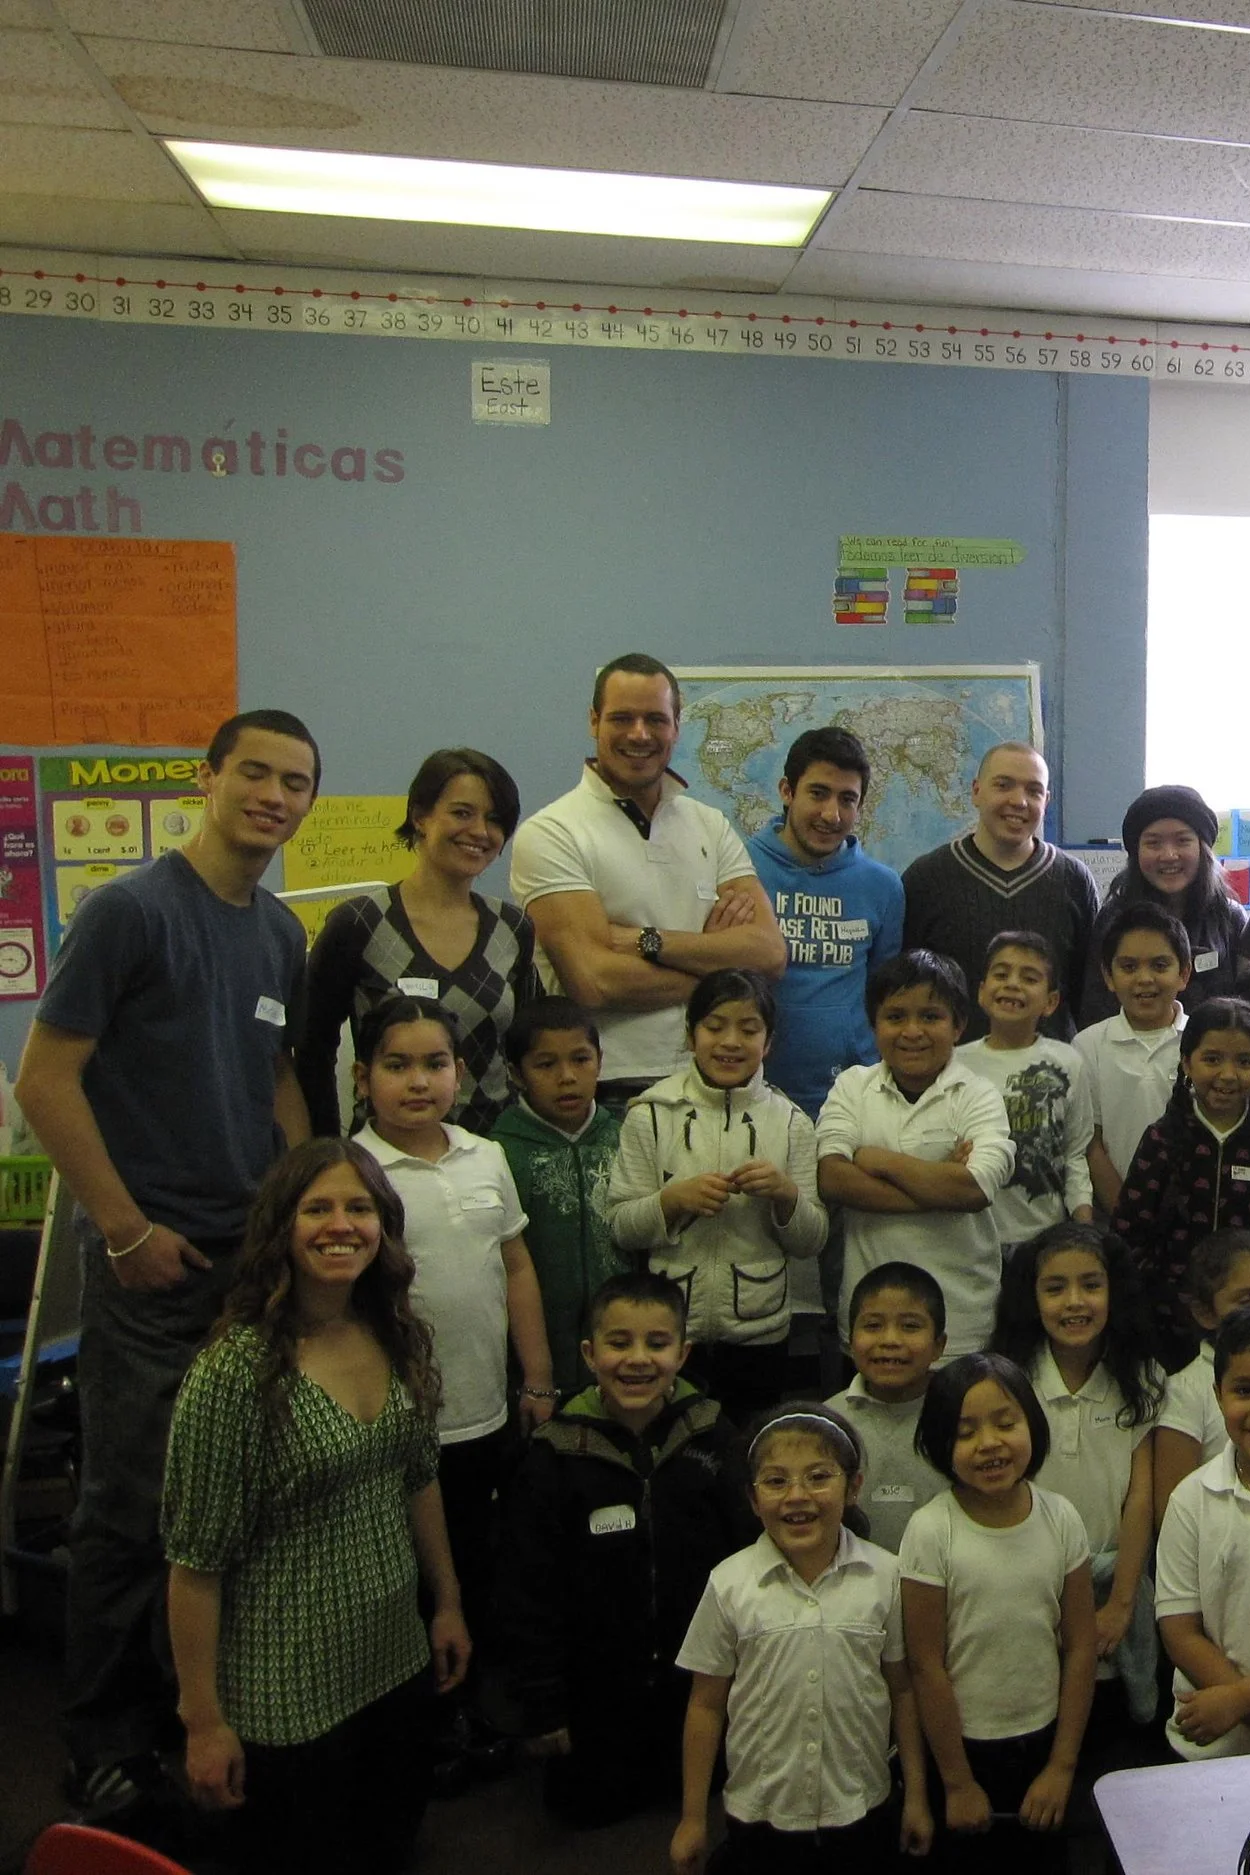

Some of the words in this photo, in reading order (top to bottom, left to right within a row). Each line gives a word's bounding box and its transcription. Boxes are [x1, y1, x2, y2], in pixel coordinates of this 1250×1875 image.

[25, 290, 52, 309] 29
[65, 292, 96, 313] 30
[113, 296, 131, 315] 31
[149, 298, 174, 318] 32
[188, 301, 215, 321] 33
[228, 303, 253, 322] 34
[267, 305, 292, 325] 35
[305, 307, 330, 327] 36
[344, 310, 367, 329] 37
[381, 312, 407, 331] 38
[418, 314, 443, 333] 39
[454, 316, 480, 334] 40
[496, 318, 513, 336] 41
[529, 319, 552, 338] 42
[565, 321, 589, 339] 43
[601, 323, 625, 341] 44
[636, 325, 660, 343] 45
[671, 326, 694, 345] 46
[707, 328, 729, 347] 47
[740, 330, 763, 349] 48
[774, 332, 797, 351] 49
[807, 334, 832, 352] 50
[846, 336, 861, 354] 51
[875, 338, 897, 356] 52
[908, 340, 930, 358] 53
[941, 342, 962, 360] 54
[974, 344, 995, 363] 55
[1005, 346, 1027, 364] 56
[1038, 348, 1058, 366] 57
[1069, 349, 1091, 368] 58
[1101, 351, 1122, 370] 59
[1131, 354, 1154, 372] 60
[1166, 357, 1181, 374] 61
[1194, 358, 1214, 376] 62
[1224, 360, 1244, 378] 63
[481, 367, 541, 396] Este
[486, 398, 529, 417] East
[866, 538, 882, 546] can
[887, 537, 907, 547] read
[900, 546, 923, 563] leer
[928, 547, 944, 563] de
[312, 800, 339, 813] ndo
[311, 811, 391, 827] terminado
[324, 844, 355, 856] Leer
[362, 841, 377, 854] tu
[776, 891, 790, 914] IF
[794, 891, 842, 918] FOUND
[778, 917, 806, 939] ASE
[788, 939, 818, 964] THE
[822, 941, 854, 964] PUB
